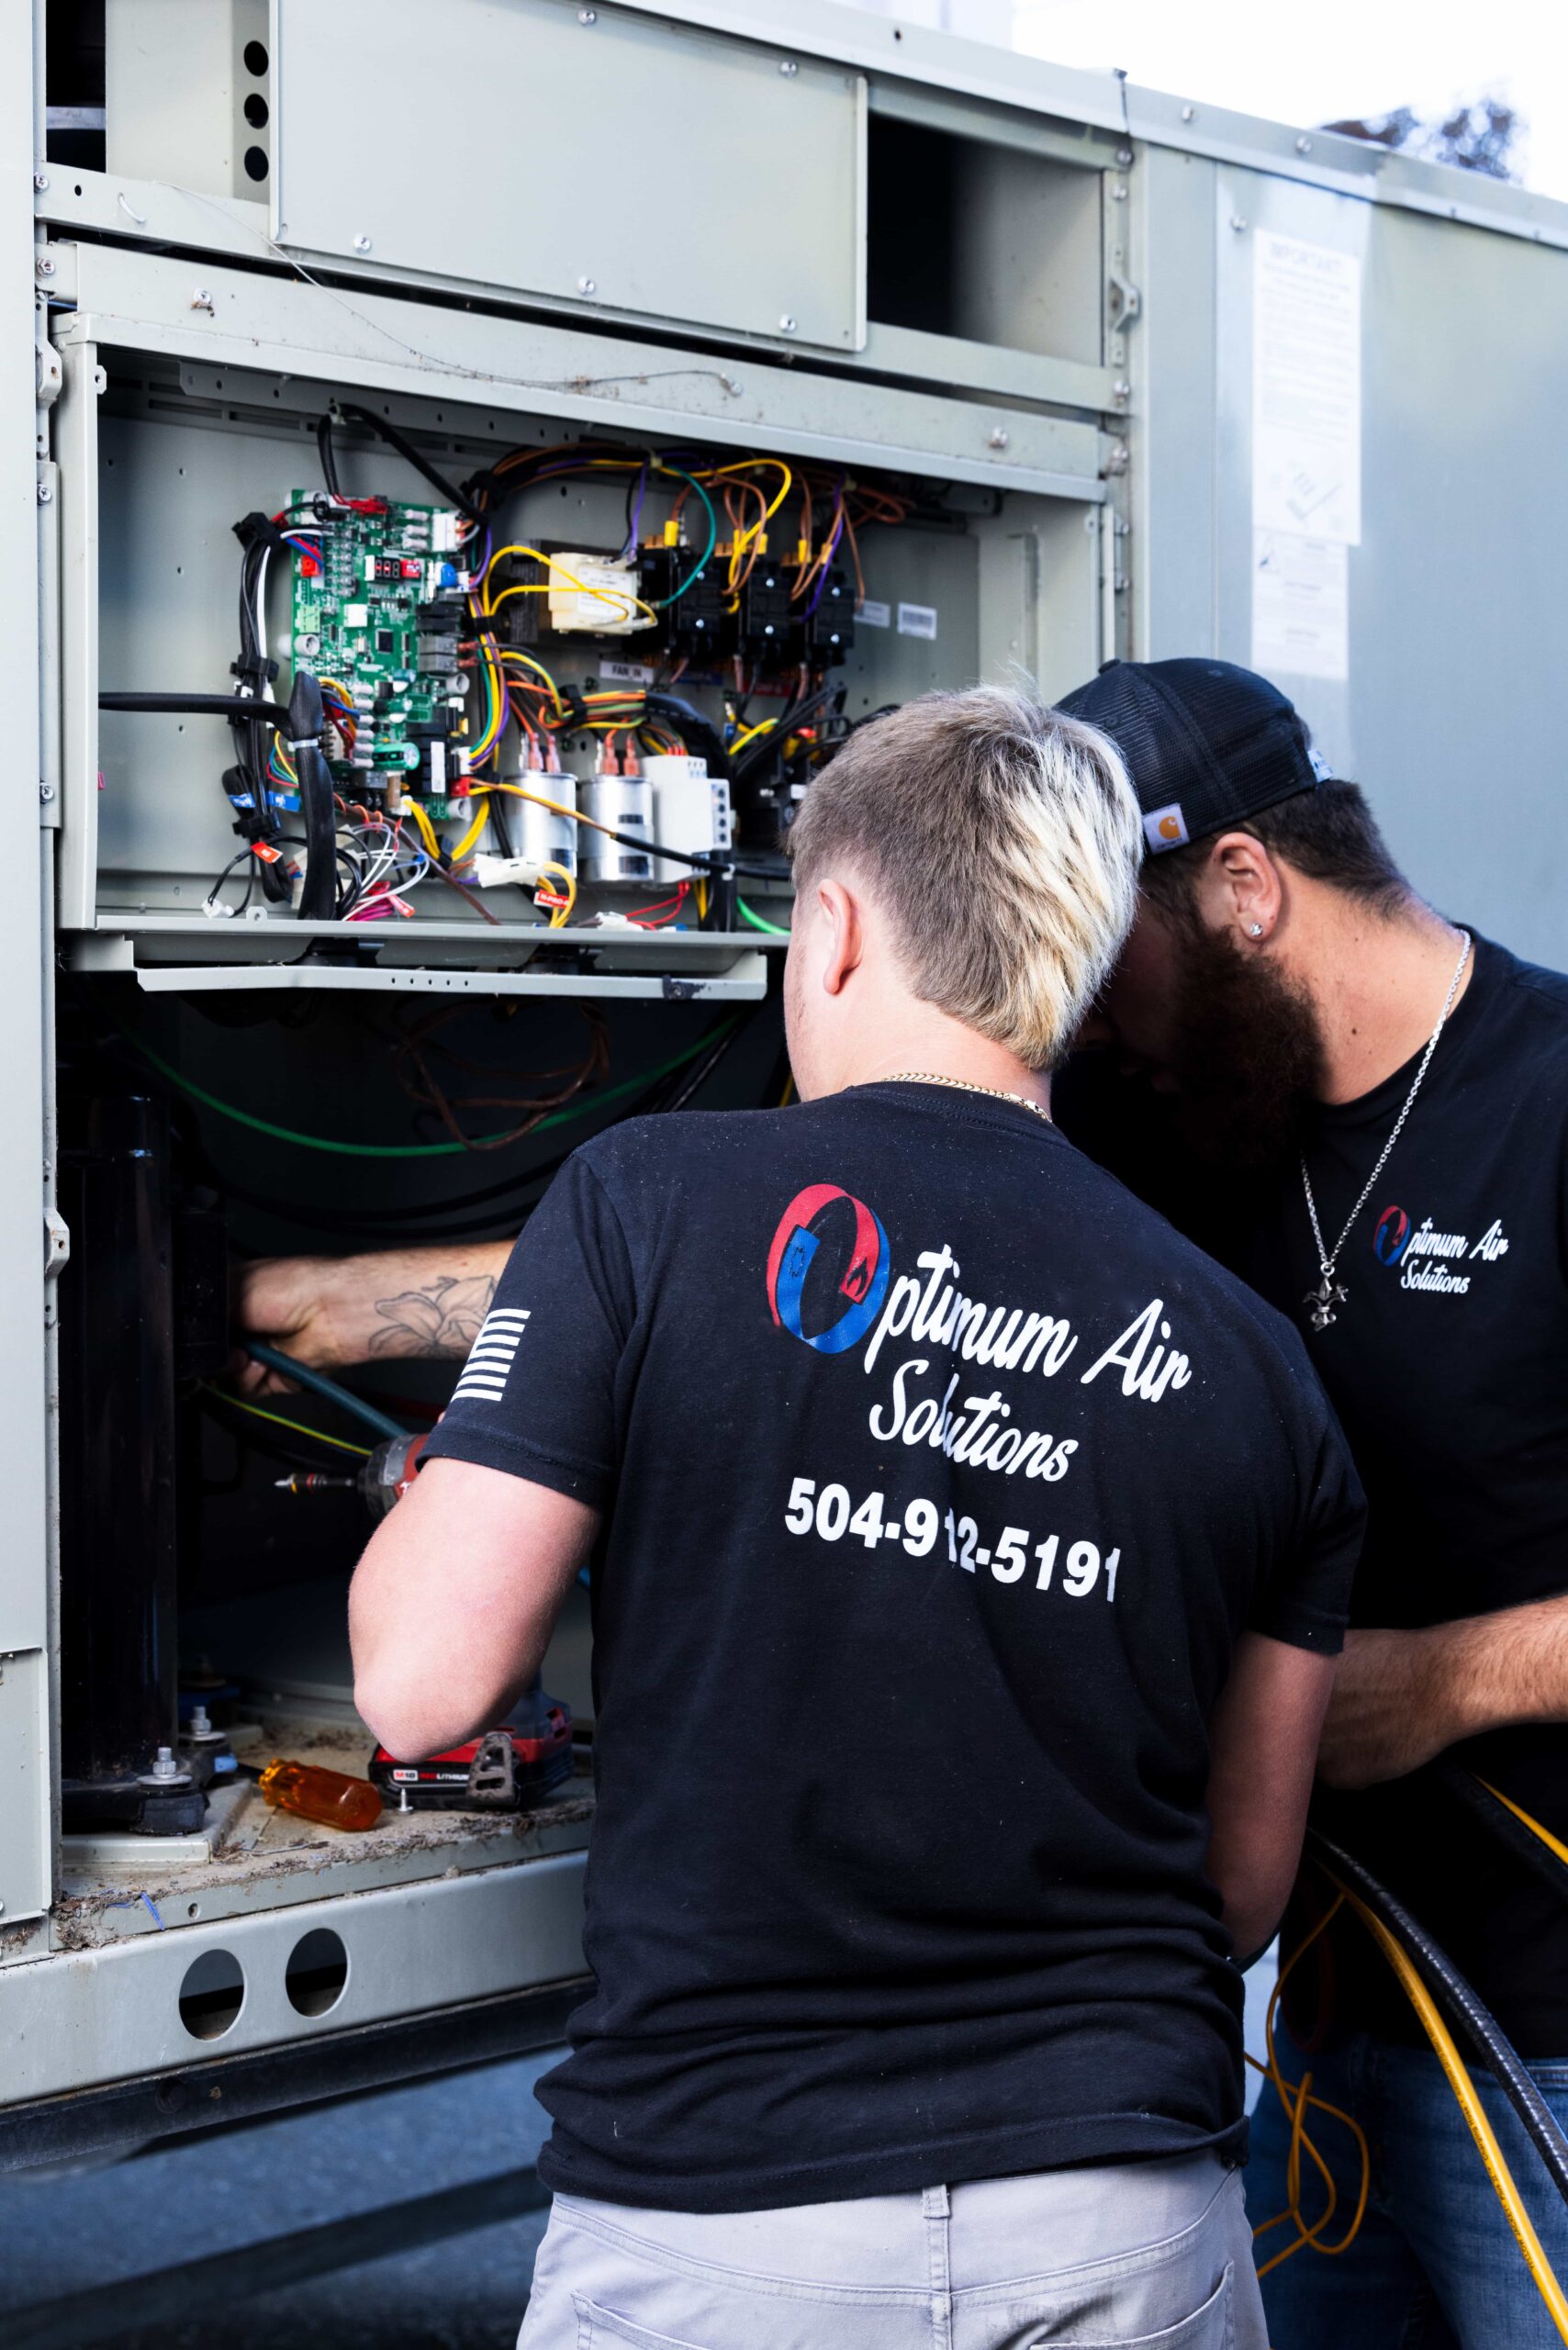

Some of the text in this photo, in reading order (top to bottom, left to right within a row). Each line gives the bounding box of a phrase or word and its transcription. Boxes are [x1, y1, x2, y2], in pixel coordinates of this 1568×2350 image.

[1469, 1219, 1509, 1261] Air
[1401, 1259, 1471, 1293] Solutions
[1081, 1299, 1193, 1403] Air
[869, 1360, 1079, 1482] Solutions
[785, 1477, 1121, 1603] 504-912-5191
[1462, 2106, 1473, 2125] Hose
[1471, 2126, 1488, 2160] Charging
[1495, 2184, 1505, 2200] Plus
[1518, 2238, 1535, 2269] YELLOW
